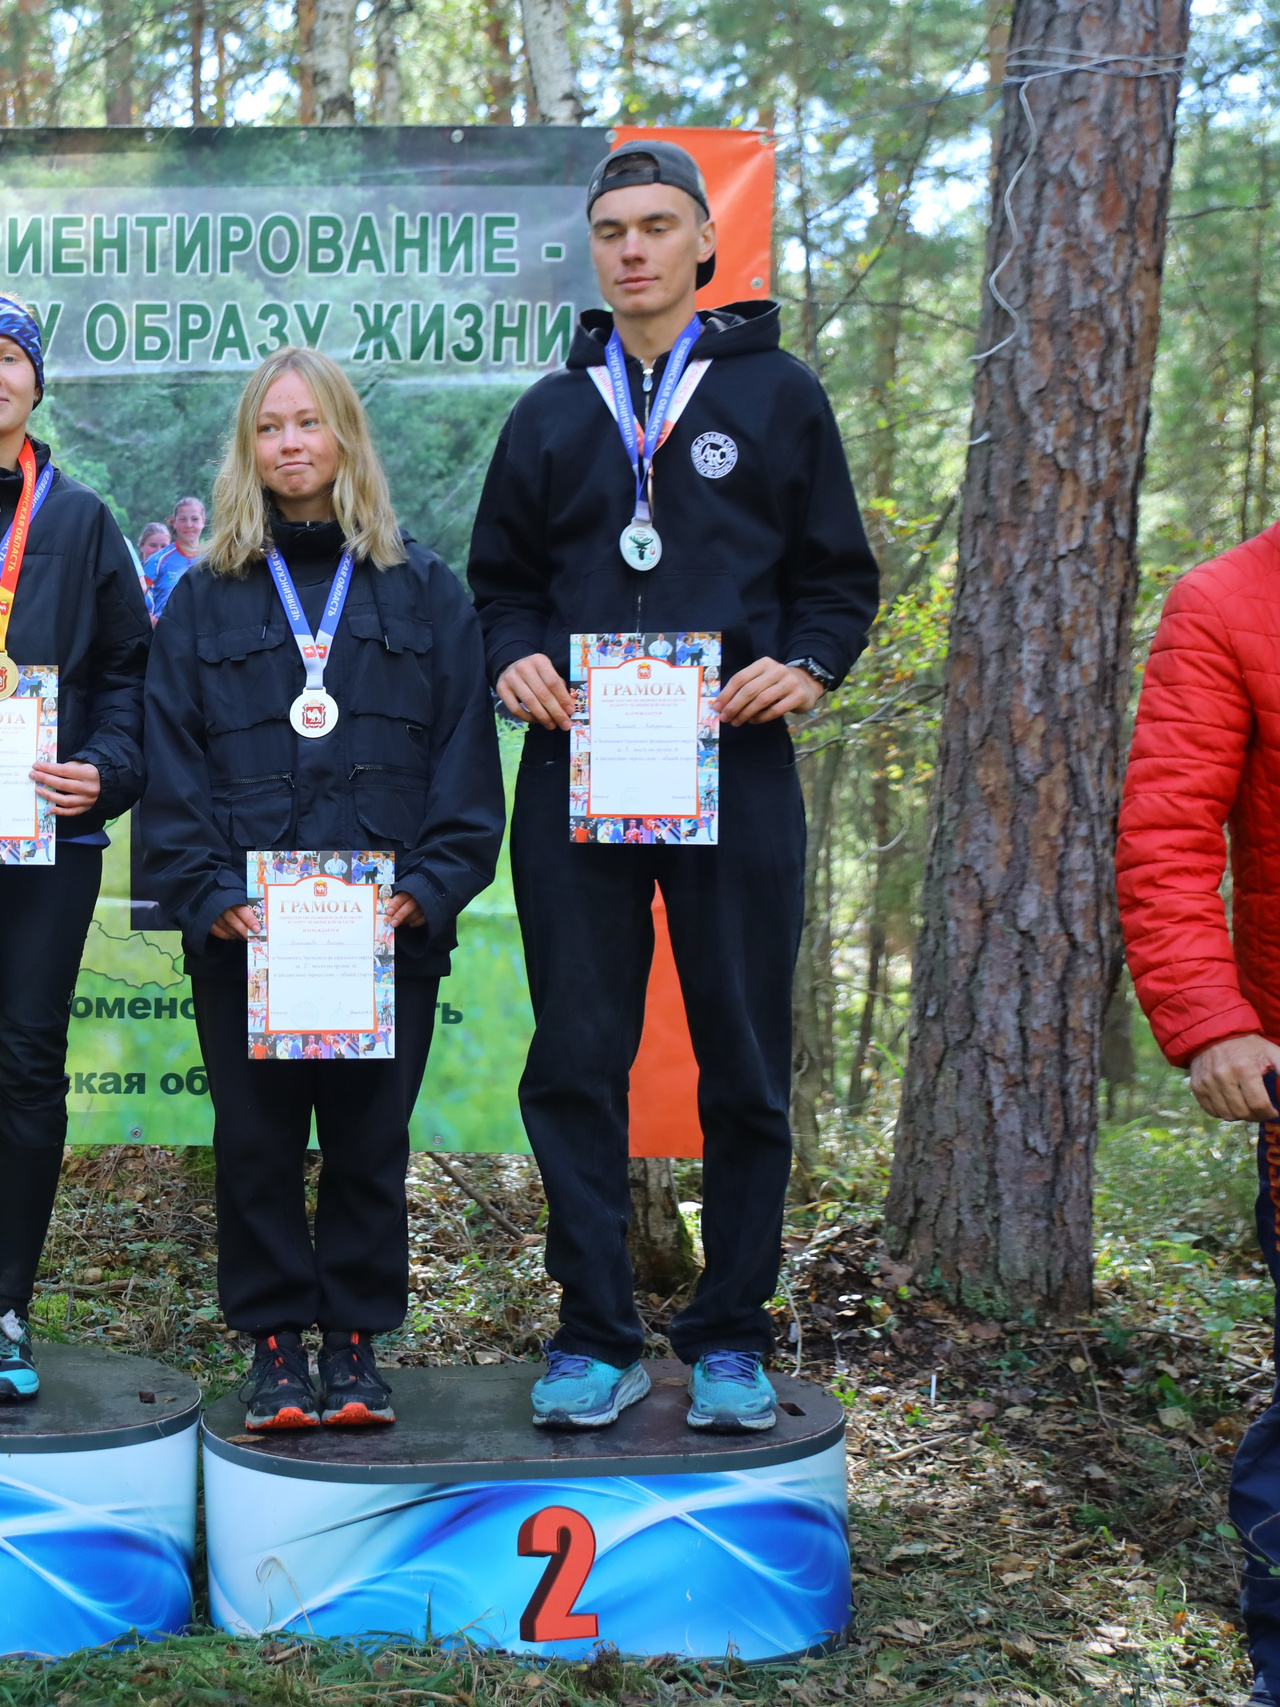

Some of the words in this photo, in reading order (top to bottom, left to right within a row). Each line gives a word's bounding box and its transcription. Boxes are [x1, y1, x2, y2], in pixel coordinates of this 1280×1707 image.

[86, 301, 332, 363] ОБРАЗУ
[352, 301, 575, 364] ЖИЗНИ
[647, 398, 668, 442] ОБЛАСТЬ
[17, 460, 33, 524] ЧЕЛЯБИНСКАЯ
[7, 524, 24, 572] ОБЛАСТЬ
[272, 560, 301, 621] ЧЕЛЯБИНСКАЯ
[327, 577, 346, 617] ОБЛАСТЬ
[602, 683, 686, 696] ГРАМОТА
[279, 900, 362, 913] ГРАМОТА
[517, 1505, 599, 1643] 2
